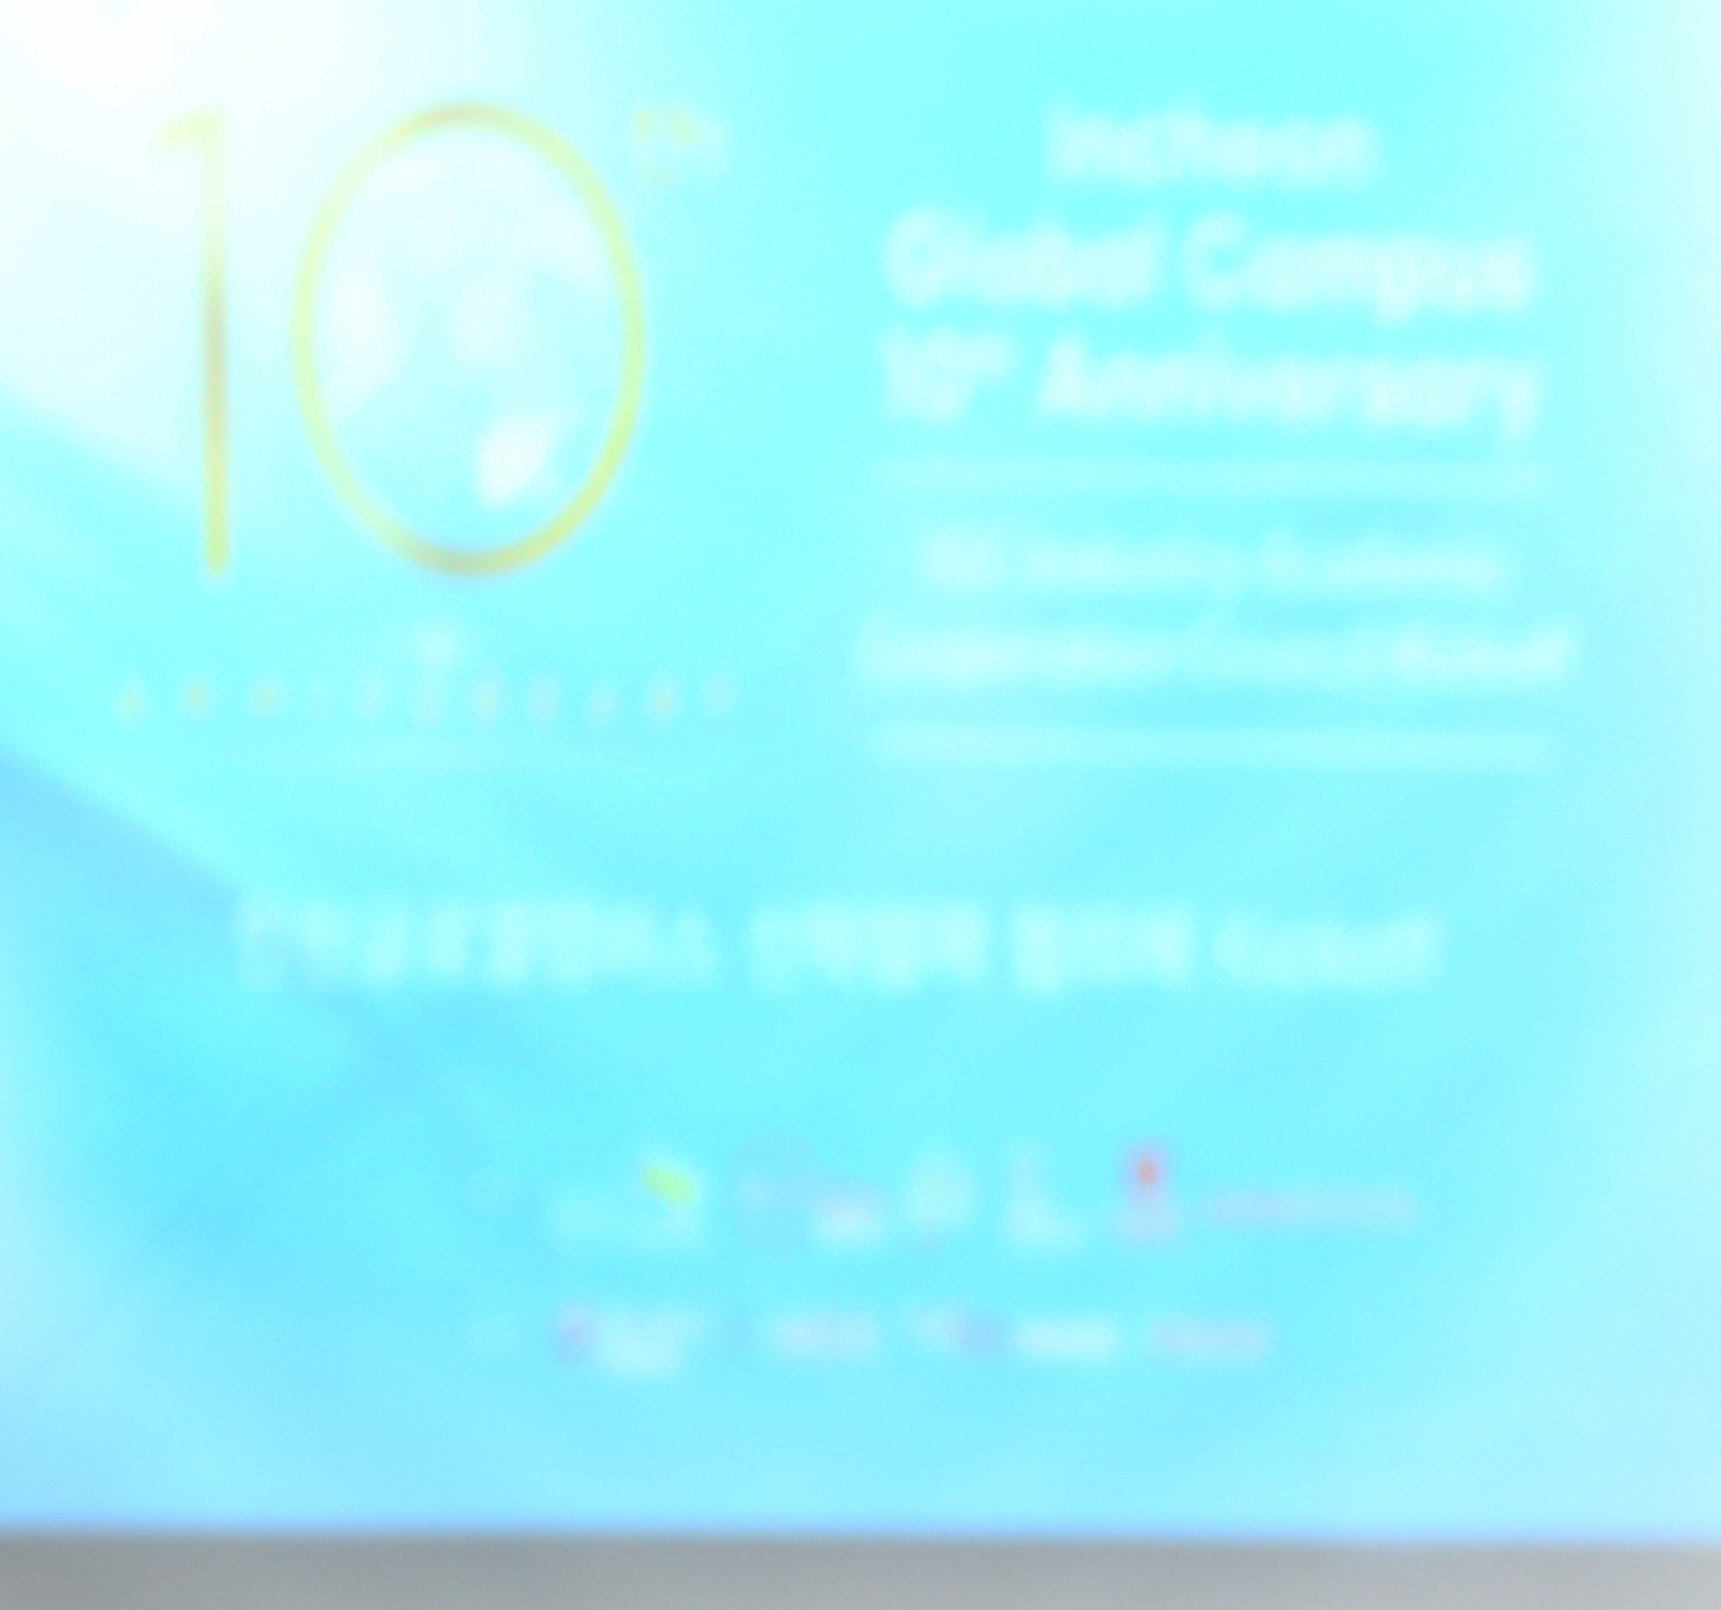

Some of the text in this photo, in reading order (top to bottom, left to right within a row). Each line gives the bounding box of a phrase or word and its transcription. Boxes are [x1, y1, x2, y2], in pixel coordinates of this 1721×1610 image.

[1046, 94, 1382, 186] Incheon
[881, 203, 1535, 327] Global Campus
[1035, 330, 1545, 443] Anniversary
